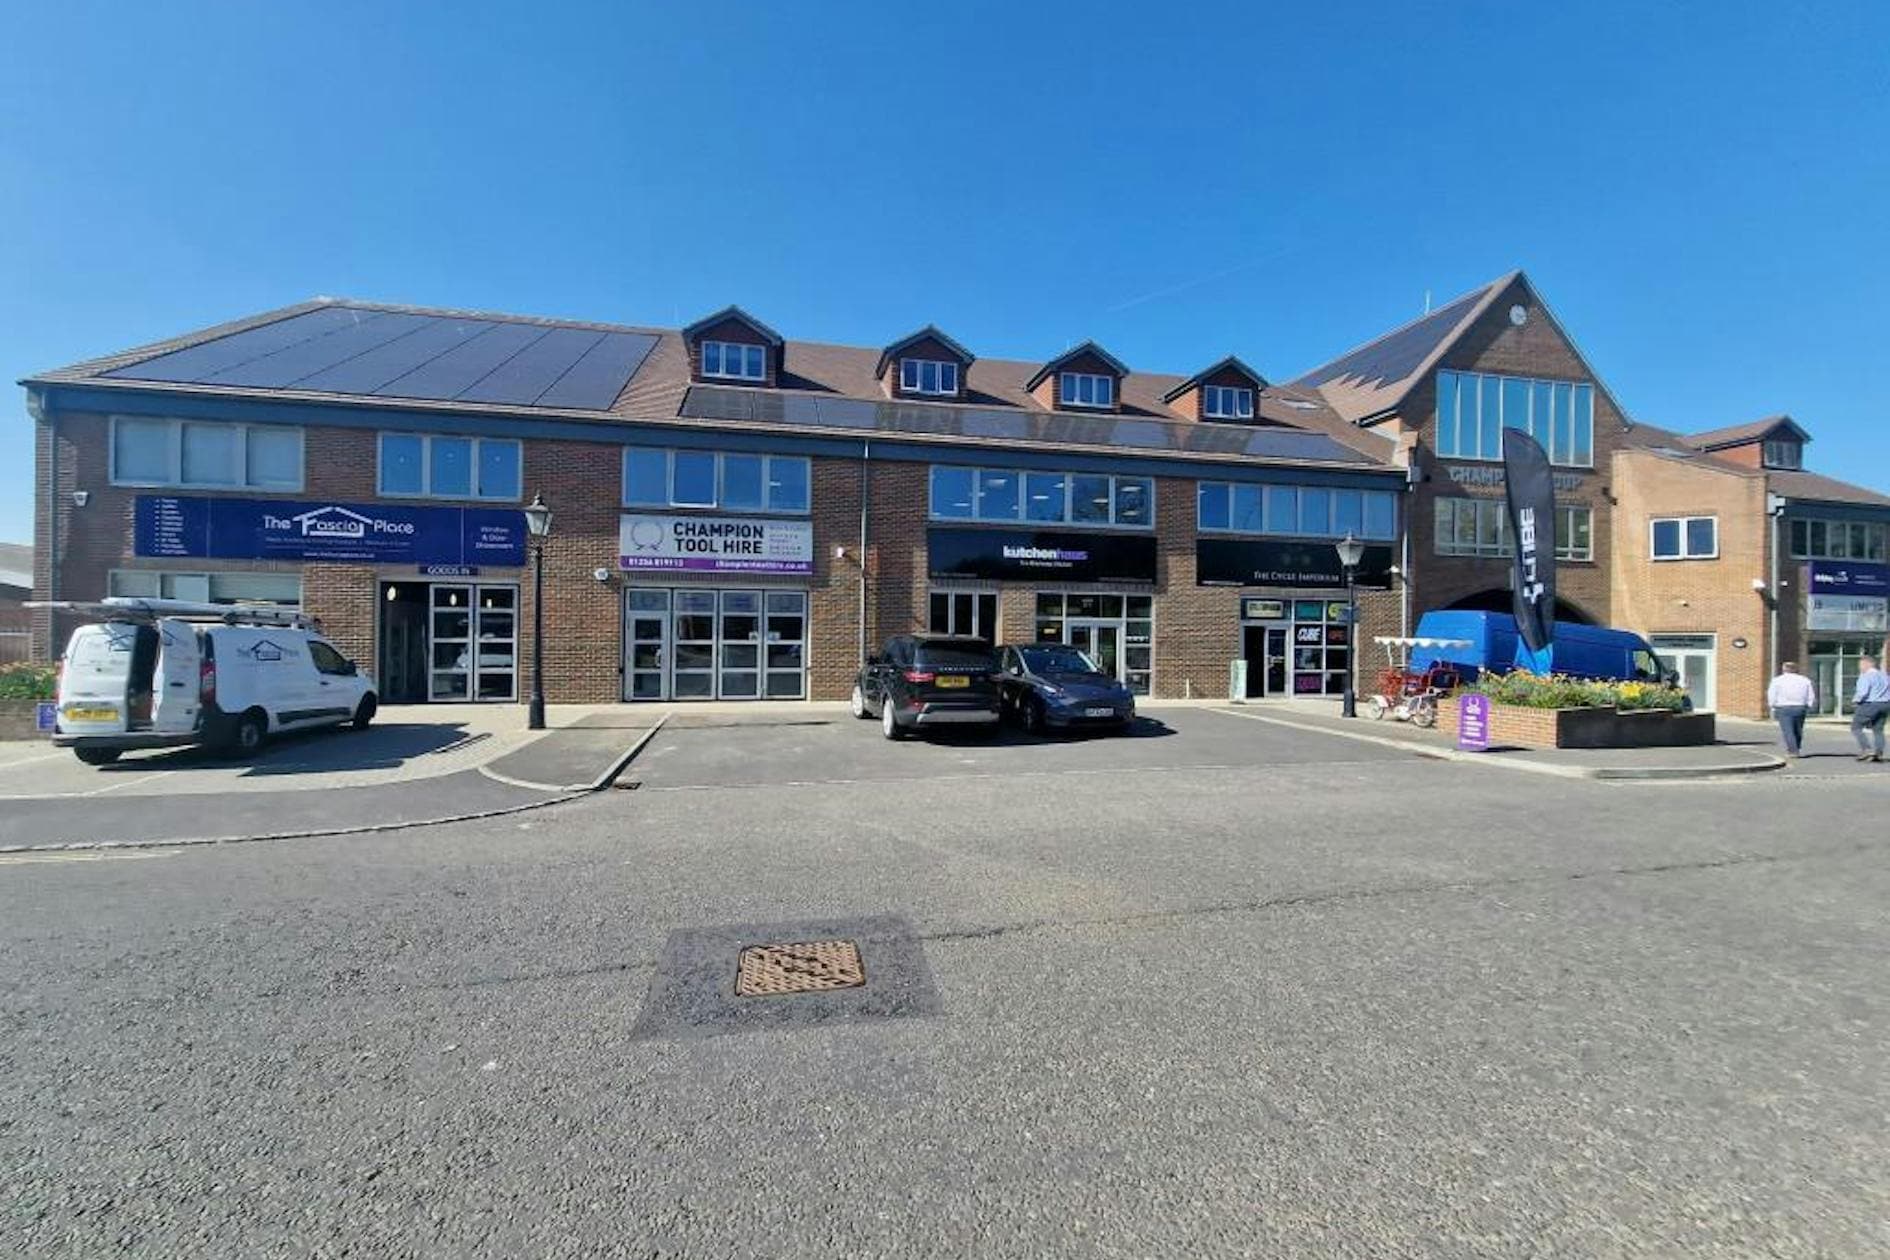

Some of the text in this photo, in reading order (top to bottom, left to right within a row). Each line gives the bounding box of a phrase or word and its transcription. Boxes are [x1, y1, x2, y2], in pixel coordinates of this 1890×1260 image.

[1449, 466, 1506, 485] CHAMP
[264, 514, 415, 537] The Fascia Place
[673, 521, 764, 539] CHAMPION
[674, 538, 763, 554] TOOL HIRE
[1003, 545, 1089, 560] kutchenhaus
[1520, 508, 1536, 582] CUBE
[1253, 571, 1269, 580] THE
[1270, 572, 1296, 580] CYCLE
